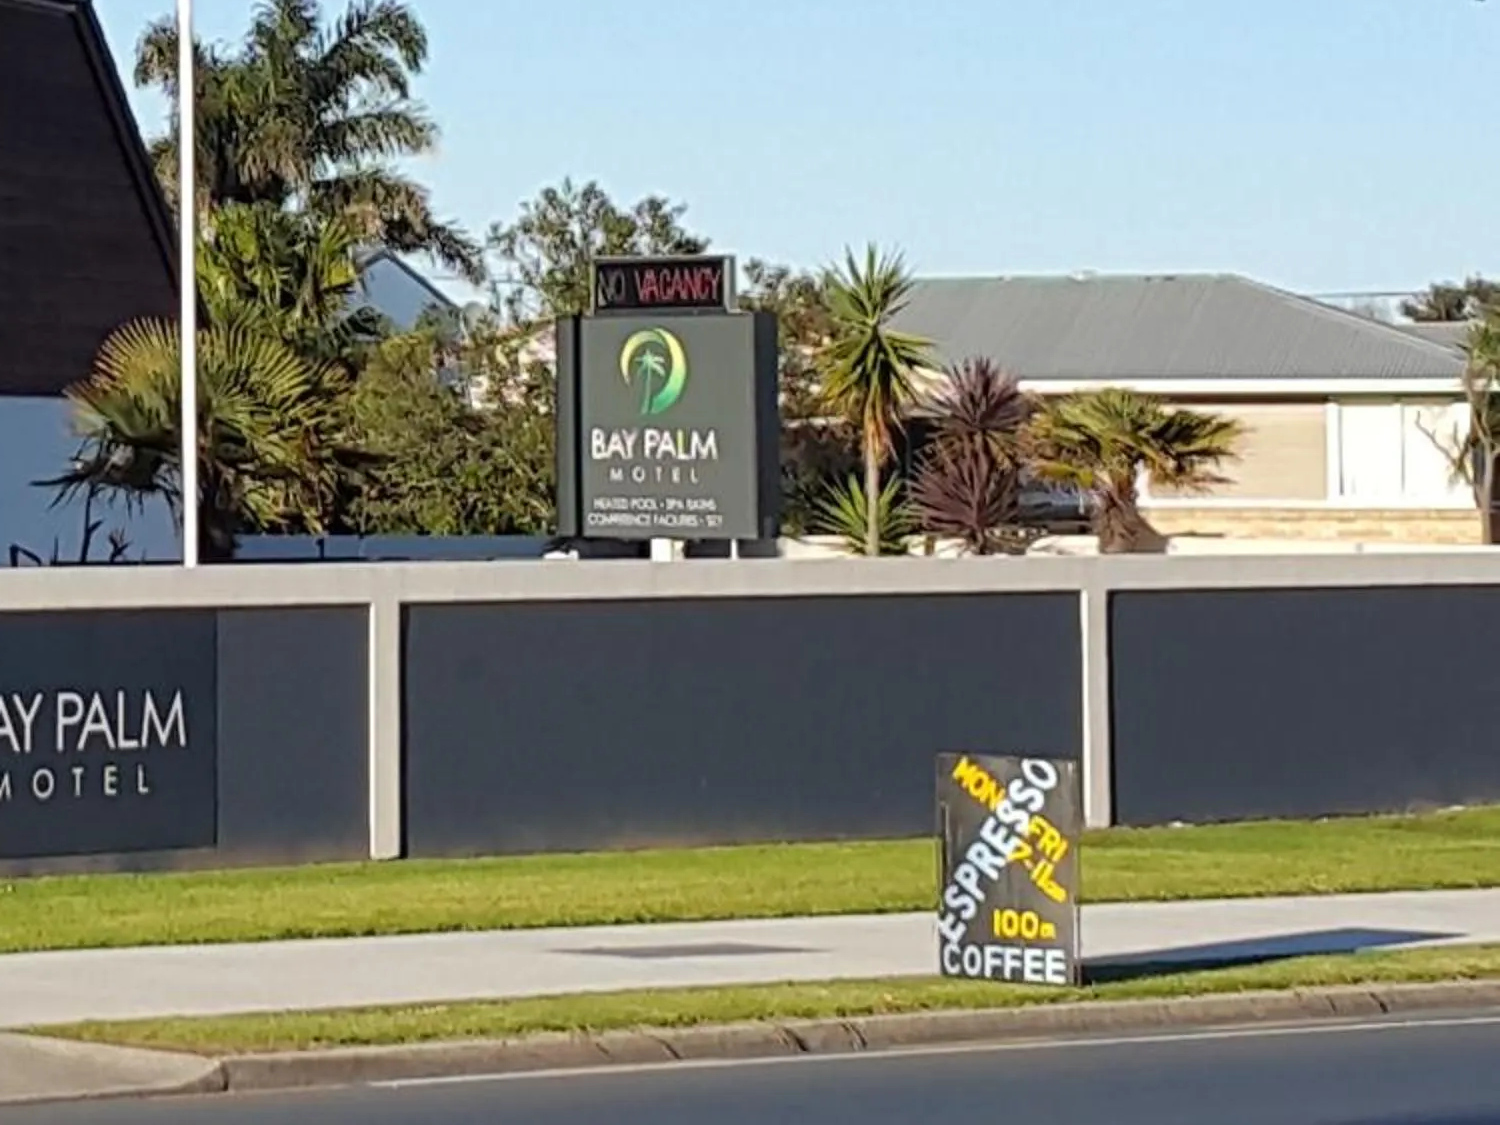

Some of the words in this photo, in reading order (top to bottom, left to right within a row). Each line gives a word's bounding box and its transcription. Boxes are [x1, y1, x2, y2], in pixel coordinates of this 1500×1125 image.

[599, 268, 625, 302] NO
[634, 266, 721, 302] VACANCY
[591, 428, 638, 461] BAY
[644, 428, 719, 461] PALM
[610, 466, 699, 483] MOTEL
[56, 689, 187, 752] PALM
[952, 756, 1006, 811] MON
[938, 758, 1058, 944] ESPRESSO
[943, 944, 1067, 984] COFFEE
